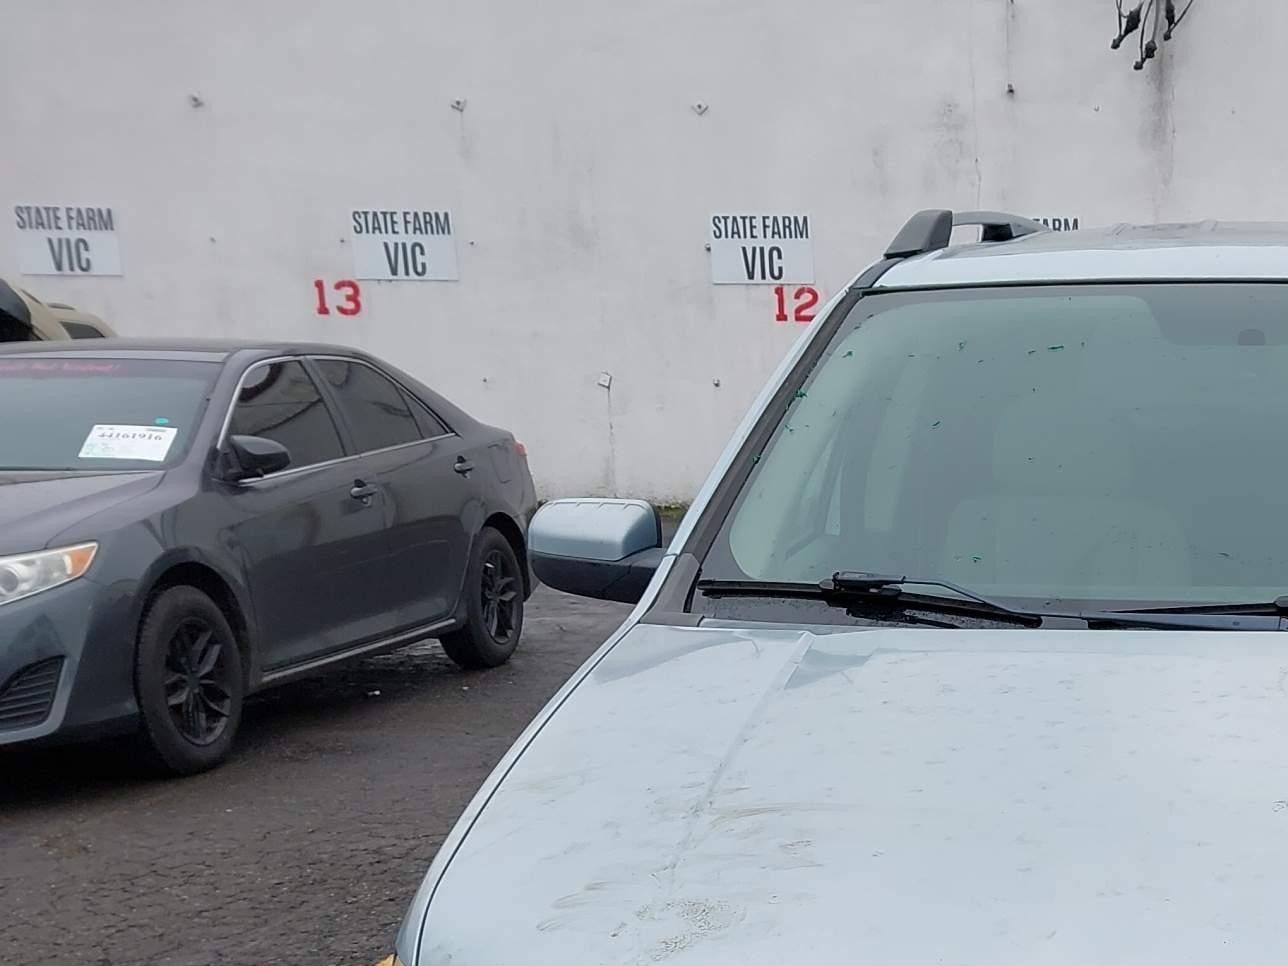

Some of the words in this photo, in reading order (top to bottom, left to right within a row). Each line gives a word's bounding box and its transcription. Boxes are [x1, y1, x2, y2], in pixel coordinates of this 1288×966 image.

[15, 205, 63, 230] STATE
[65, 207, 114, 231] FARM
[352, 210, 399, 235] STATE
[402, 211, 451, 236] FARM
[712, 215, 758, 240] STATE
[761, 215, 809, 240] FARM
[46, 237, 91, 273] VIC
[383, 241, 427, 277] VIC
[741, 246, 784, 281] VIC
[314, 279, 362, 316] 13
[774, 286, 819, 322] 12
